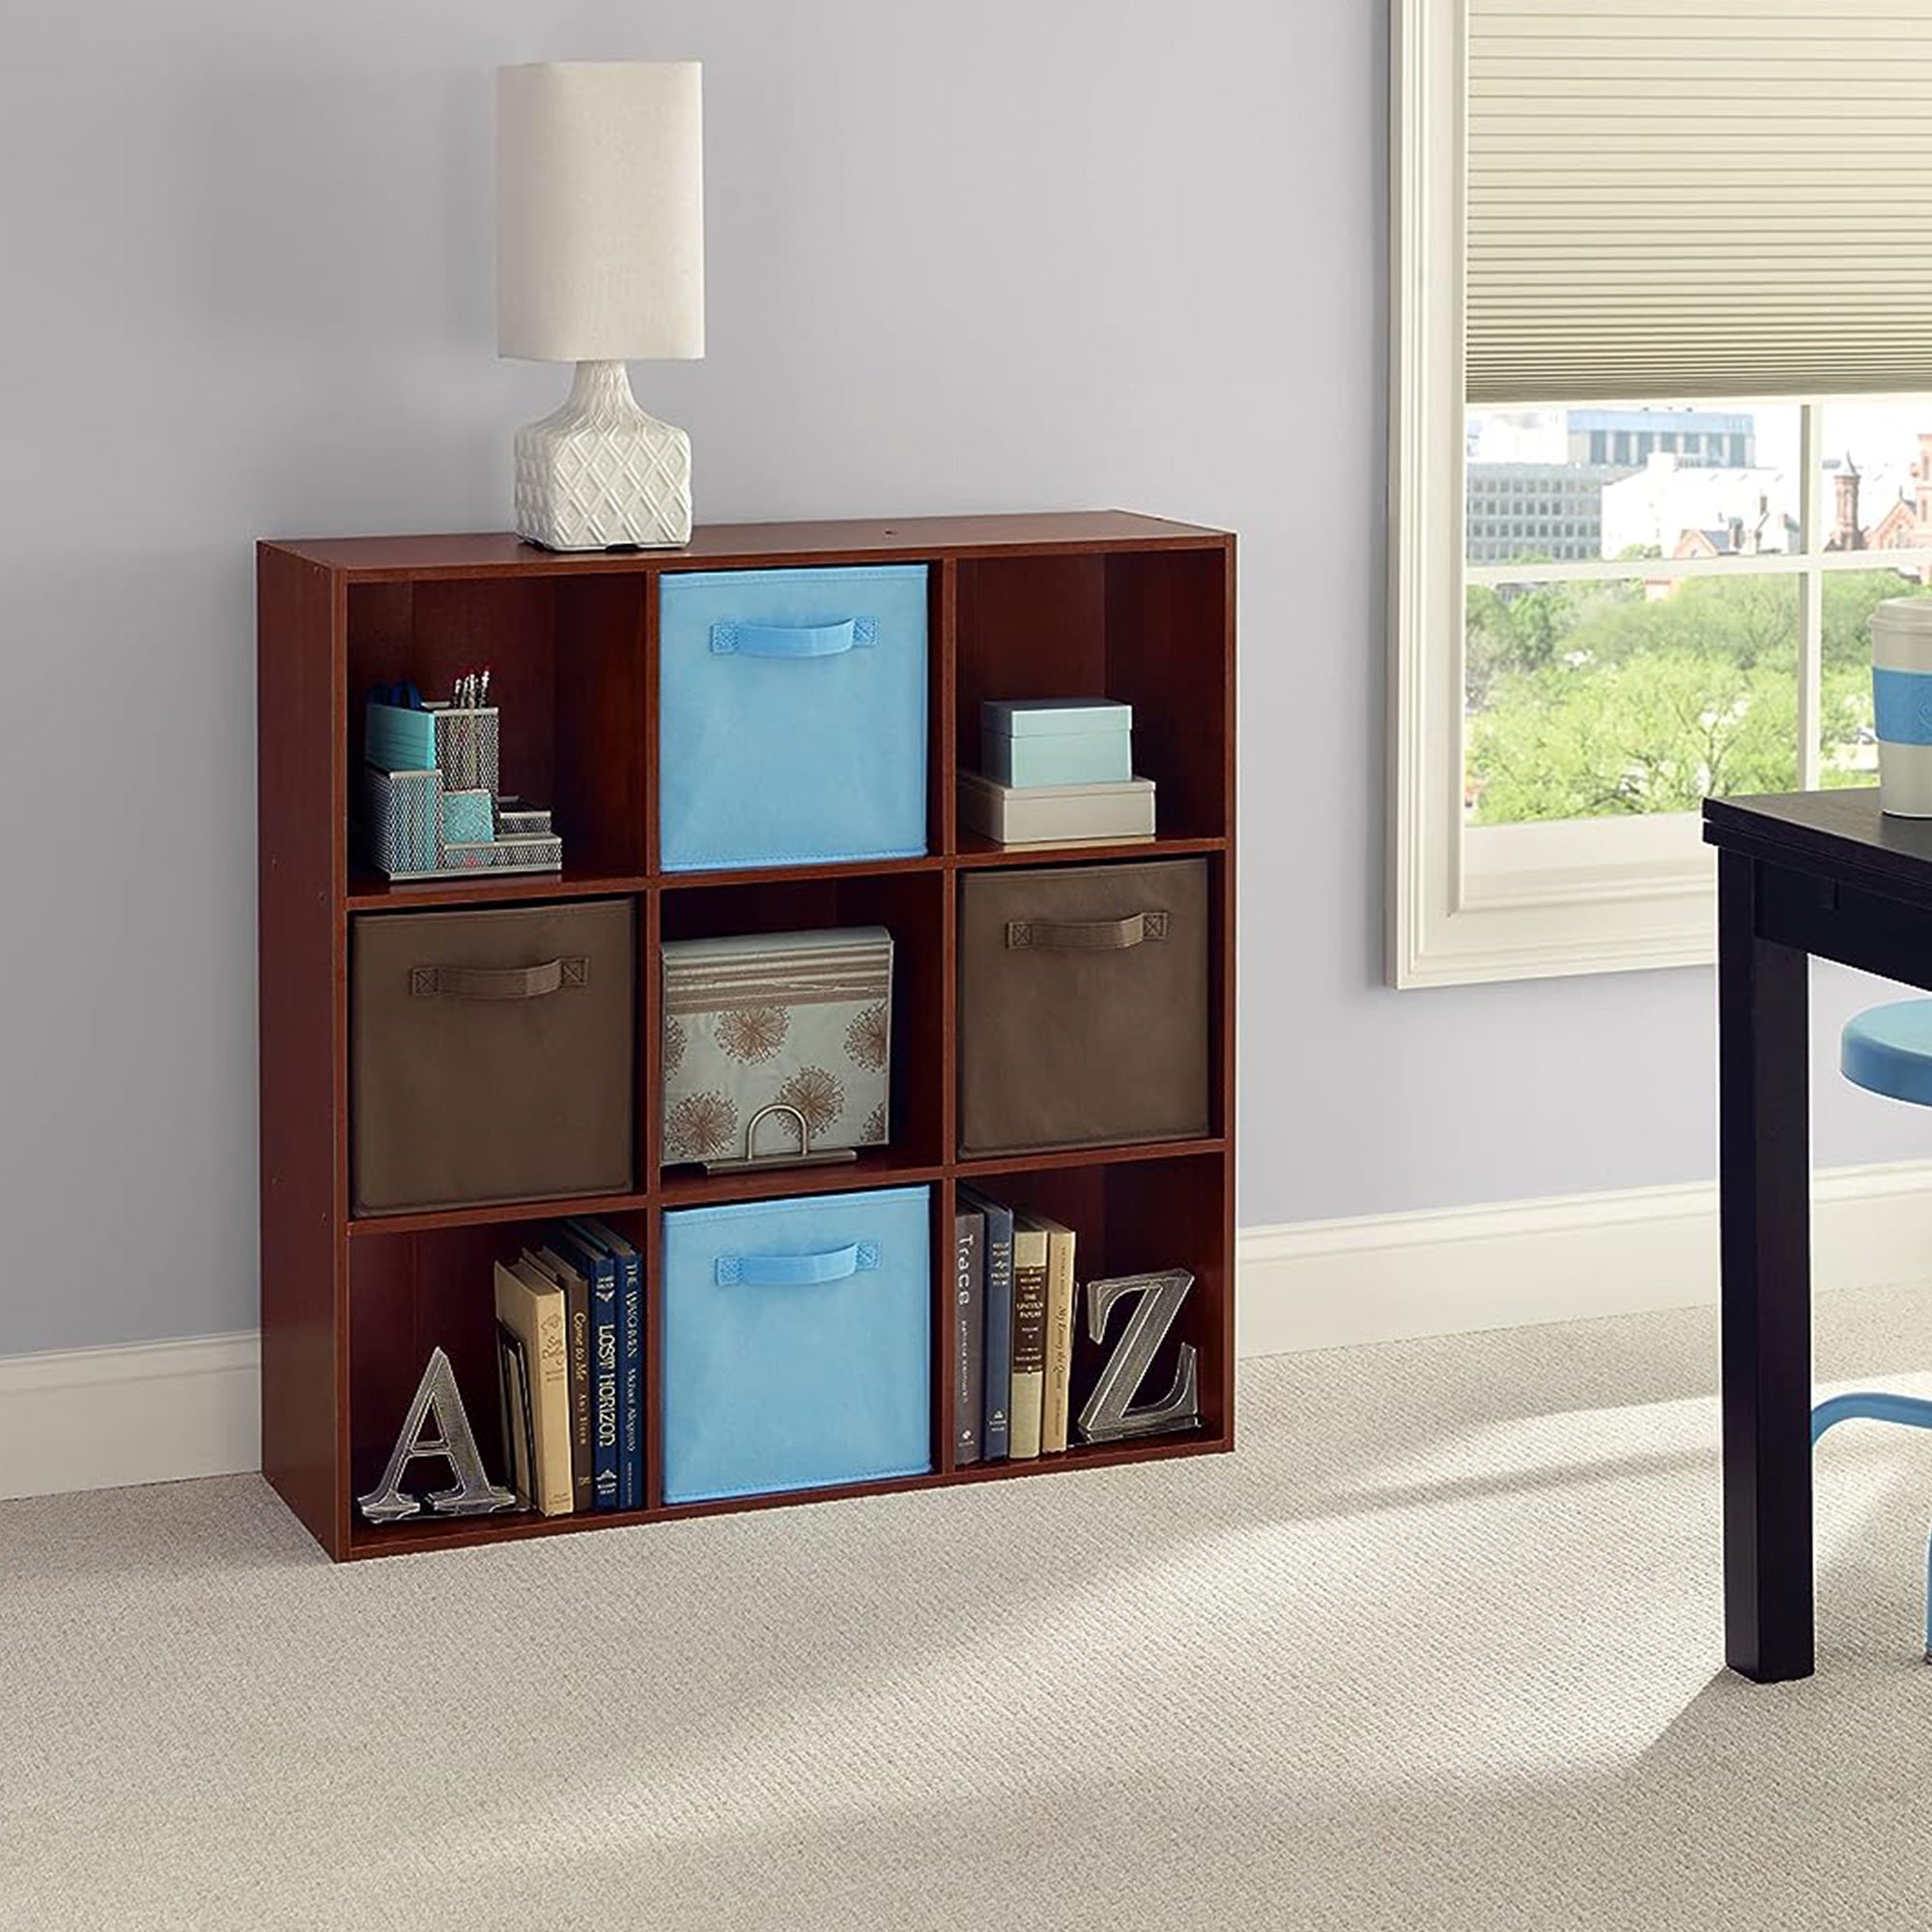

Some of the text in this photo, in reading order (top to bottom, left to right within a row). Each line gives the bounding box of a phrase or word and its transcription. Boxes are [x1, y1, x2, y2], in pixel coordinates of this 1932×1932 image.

[958, 1234, 974, 1305] Trace
[575, 1348, 584, 1361] to
[576, 1362, 587, 1381] Me
[598, 1323, 615, 1448] LOST HORIZON
[1078, 1268, 1201, 1442] Z
[357, 1346, 516, 1523] A
